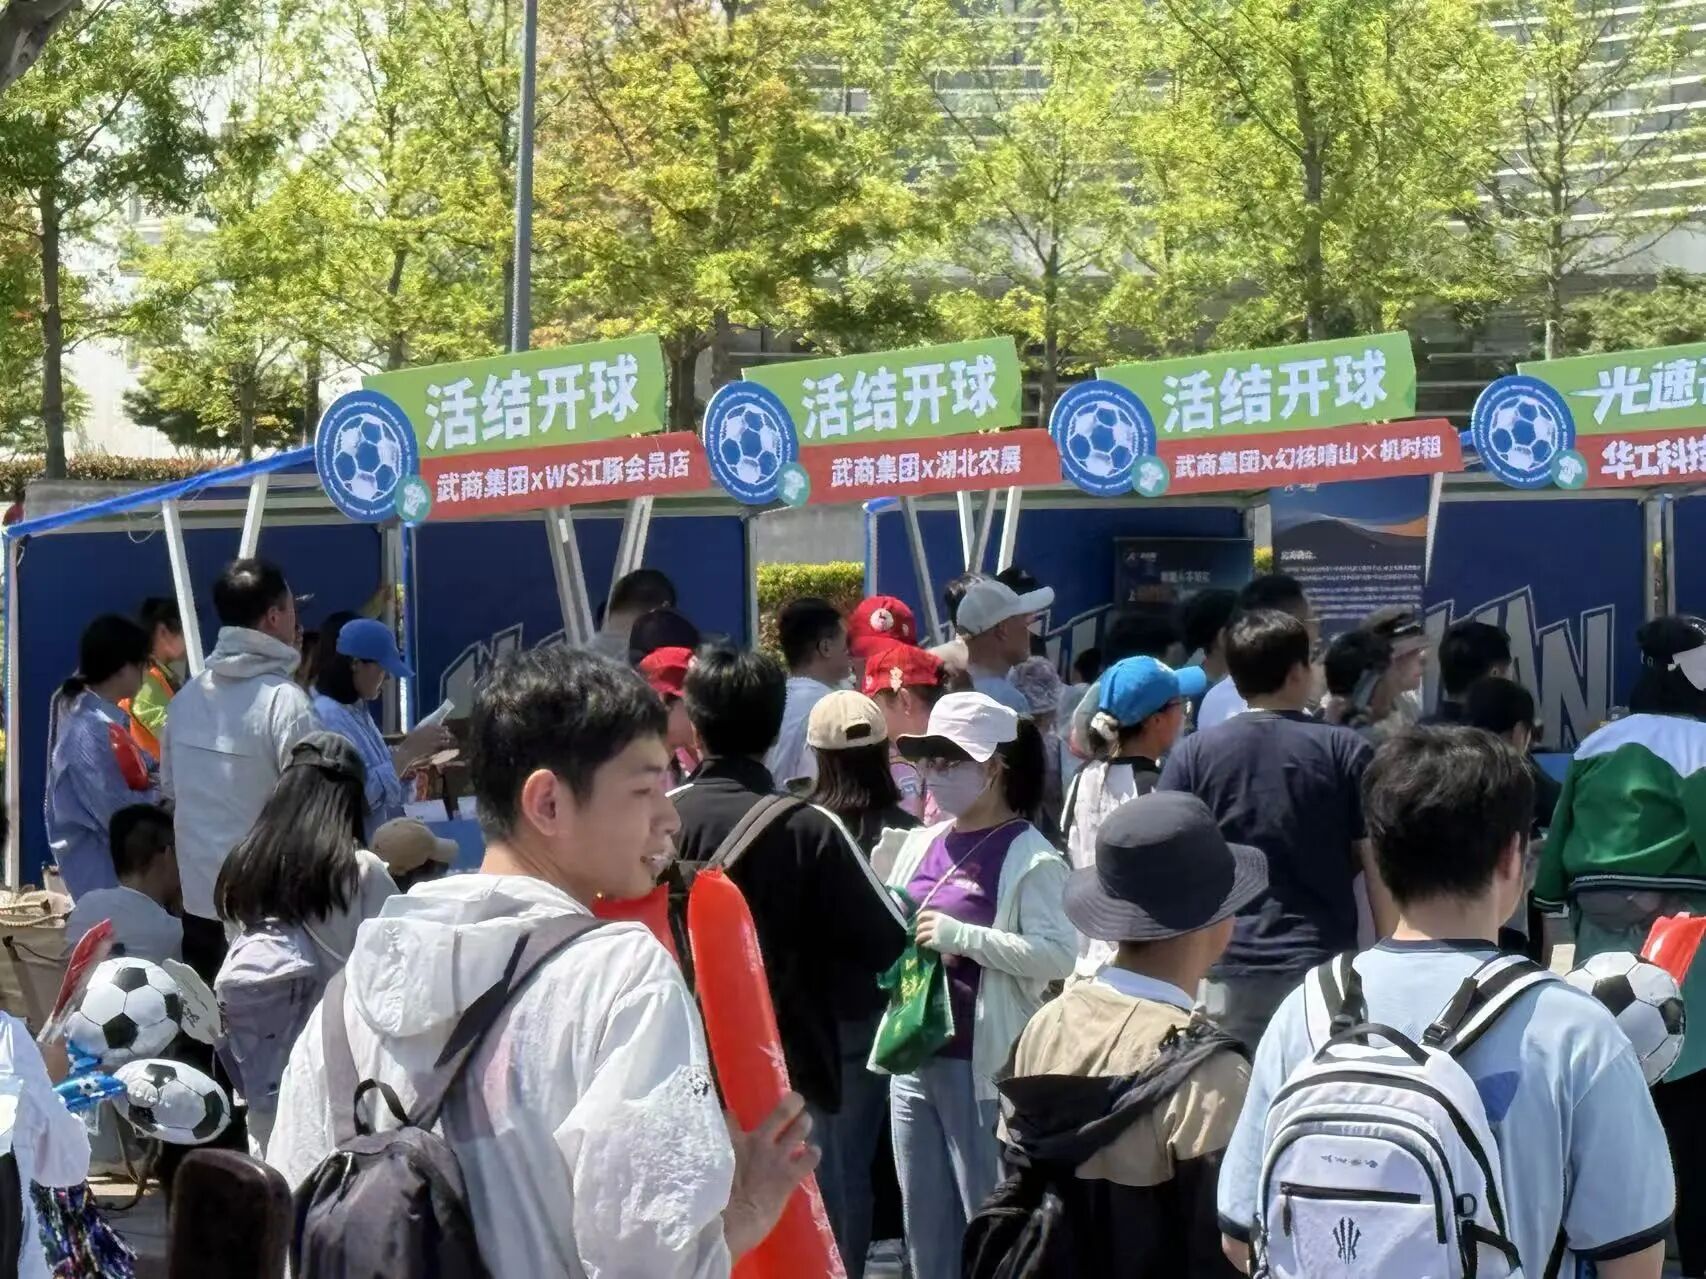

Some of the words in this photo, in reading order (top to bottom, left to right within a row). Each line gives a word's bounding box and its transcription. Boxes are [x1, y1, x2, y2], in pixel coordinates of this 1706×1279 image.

[425, 353, 639, 450] 活结开球
[801, 354, 998, 439] 活结开球
[1162, 349, 1388, 433] 活结开球
[1568, 357, 1706, 425] 光速
